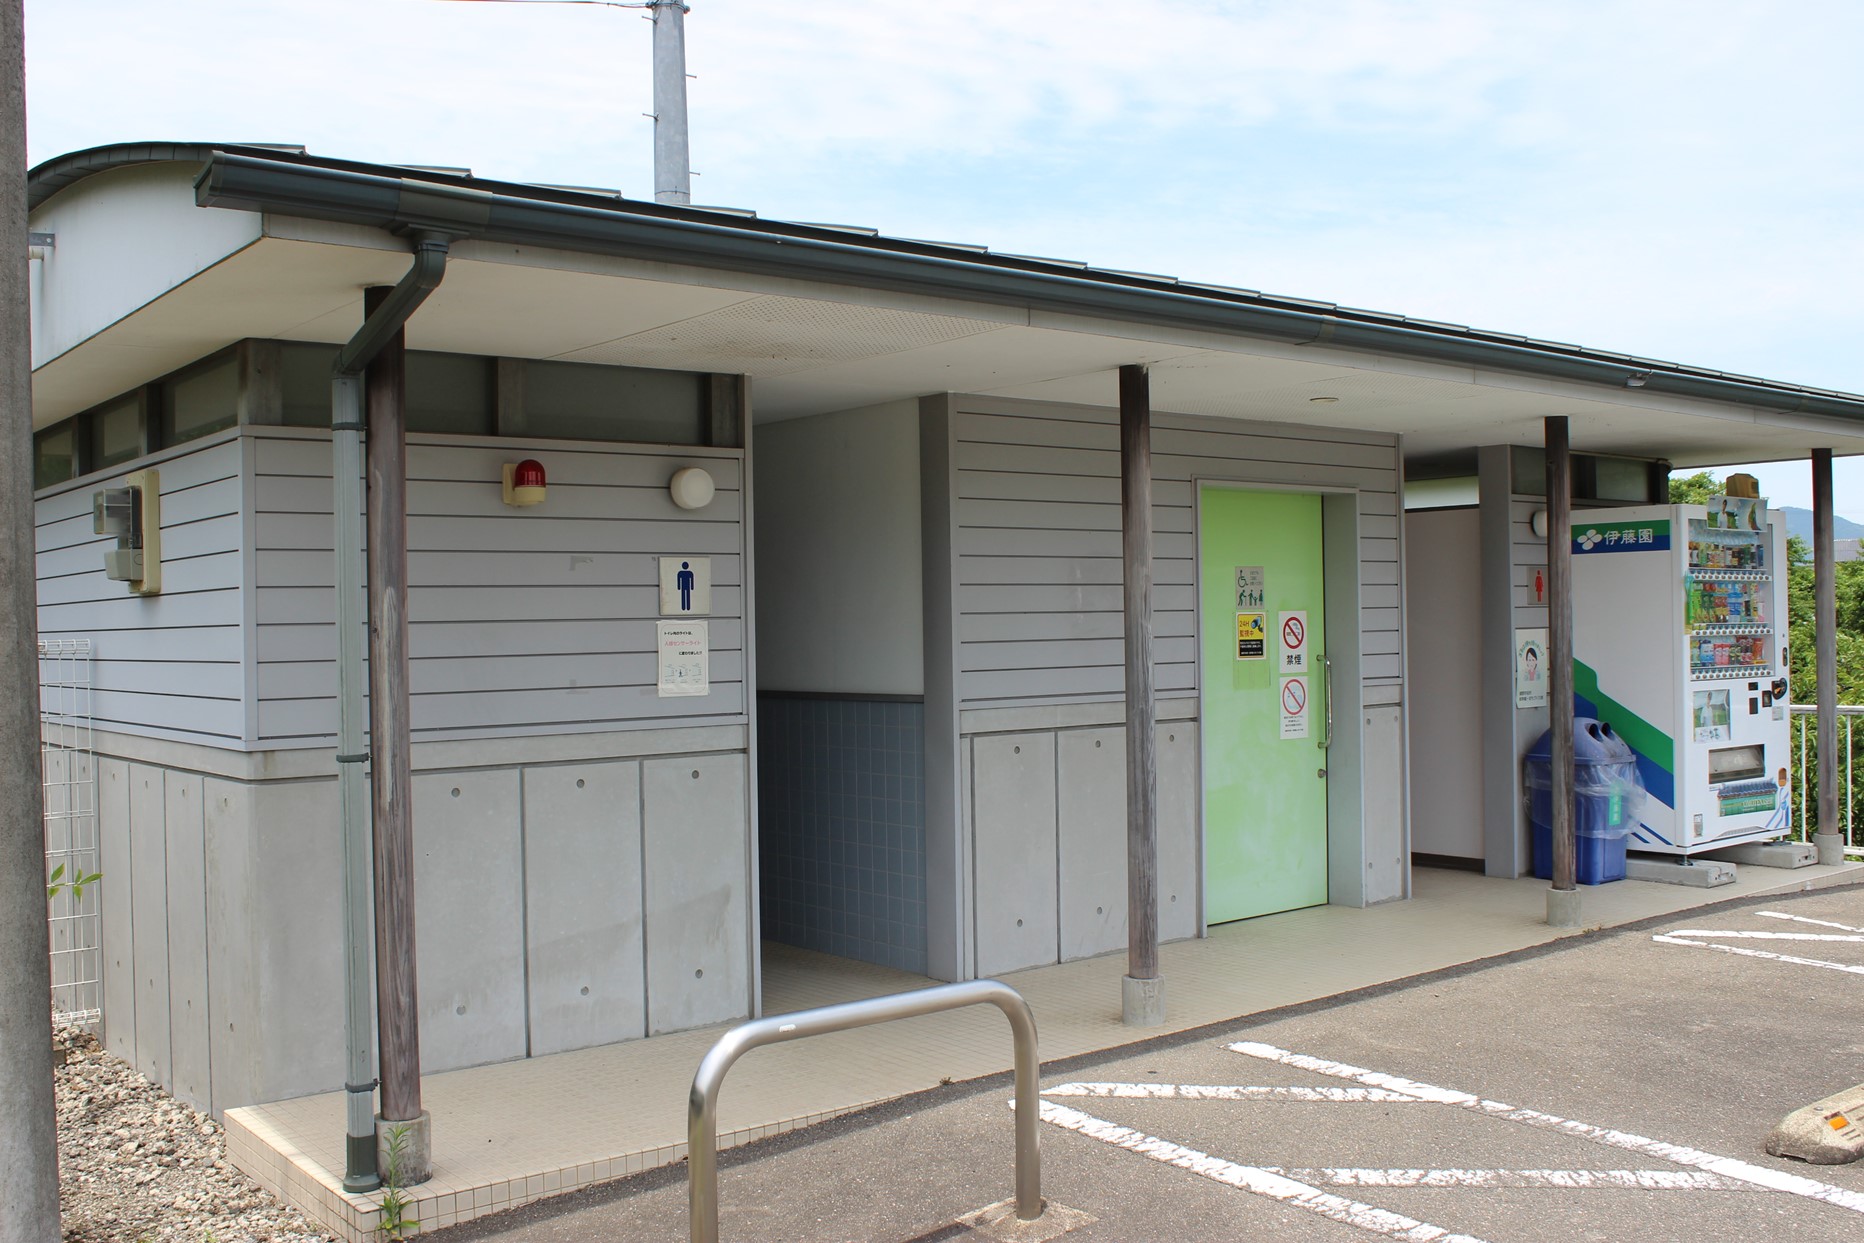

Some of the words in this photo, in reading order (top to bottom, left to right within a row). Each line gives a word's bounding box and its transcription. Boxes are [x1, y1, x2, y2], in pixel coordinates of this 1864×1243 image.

[1603, 528, 1653, 545] 伊藤園
[1239, 629, 1255, 637] 監視中
[1286, 654, 1302, 666] 禁煙
